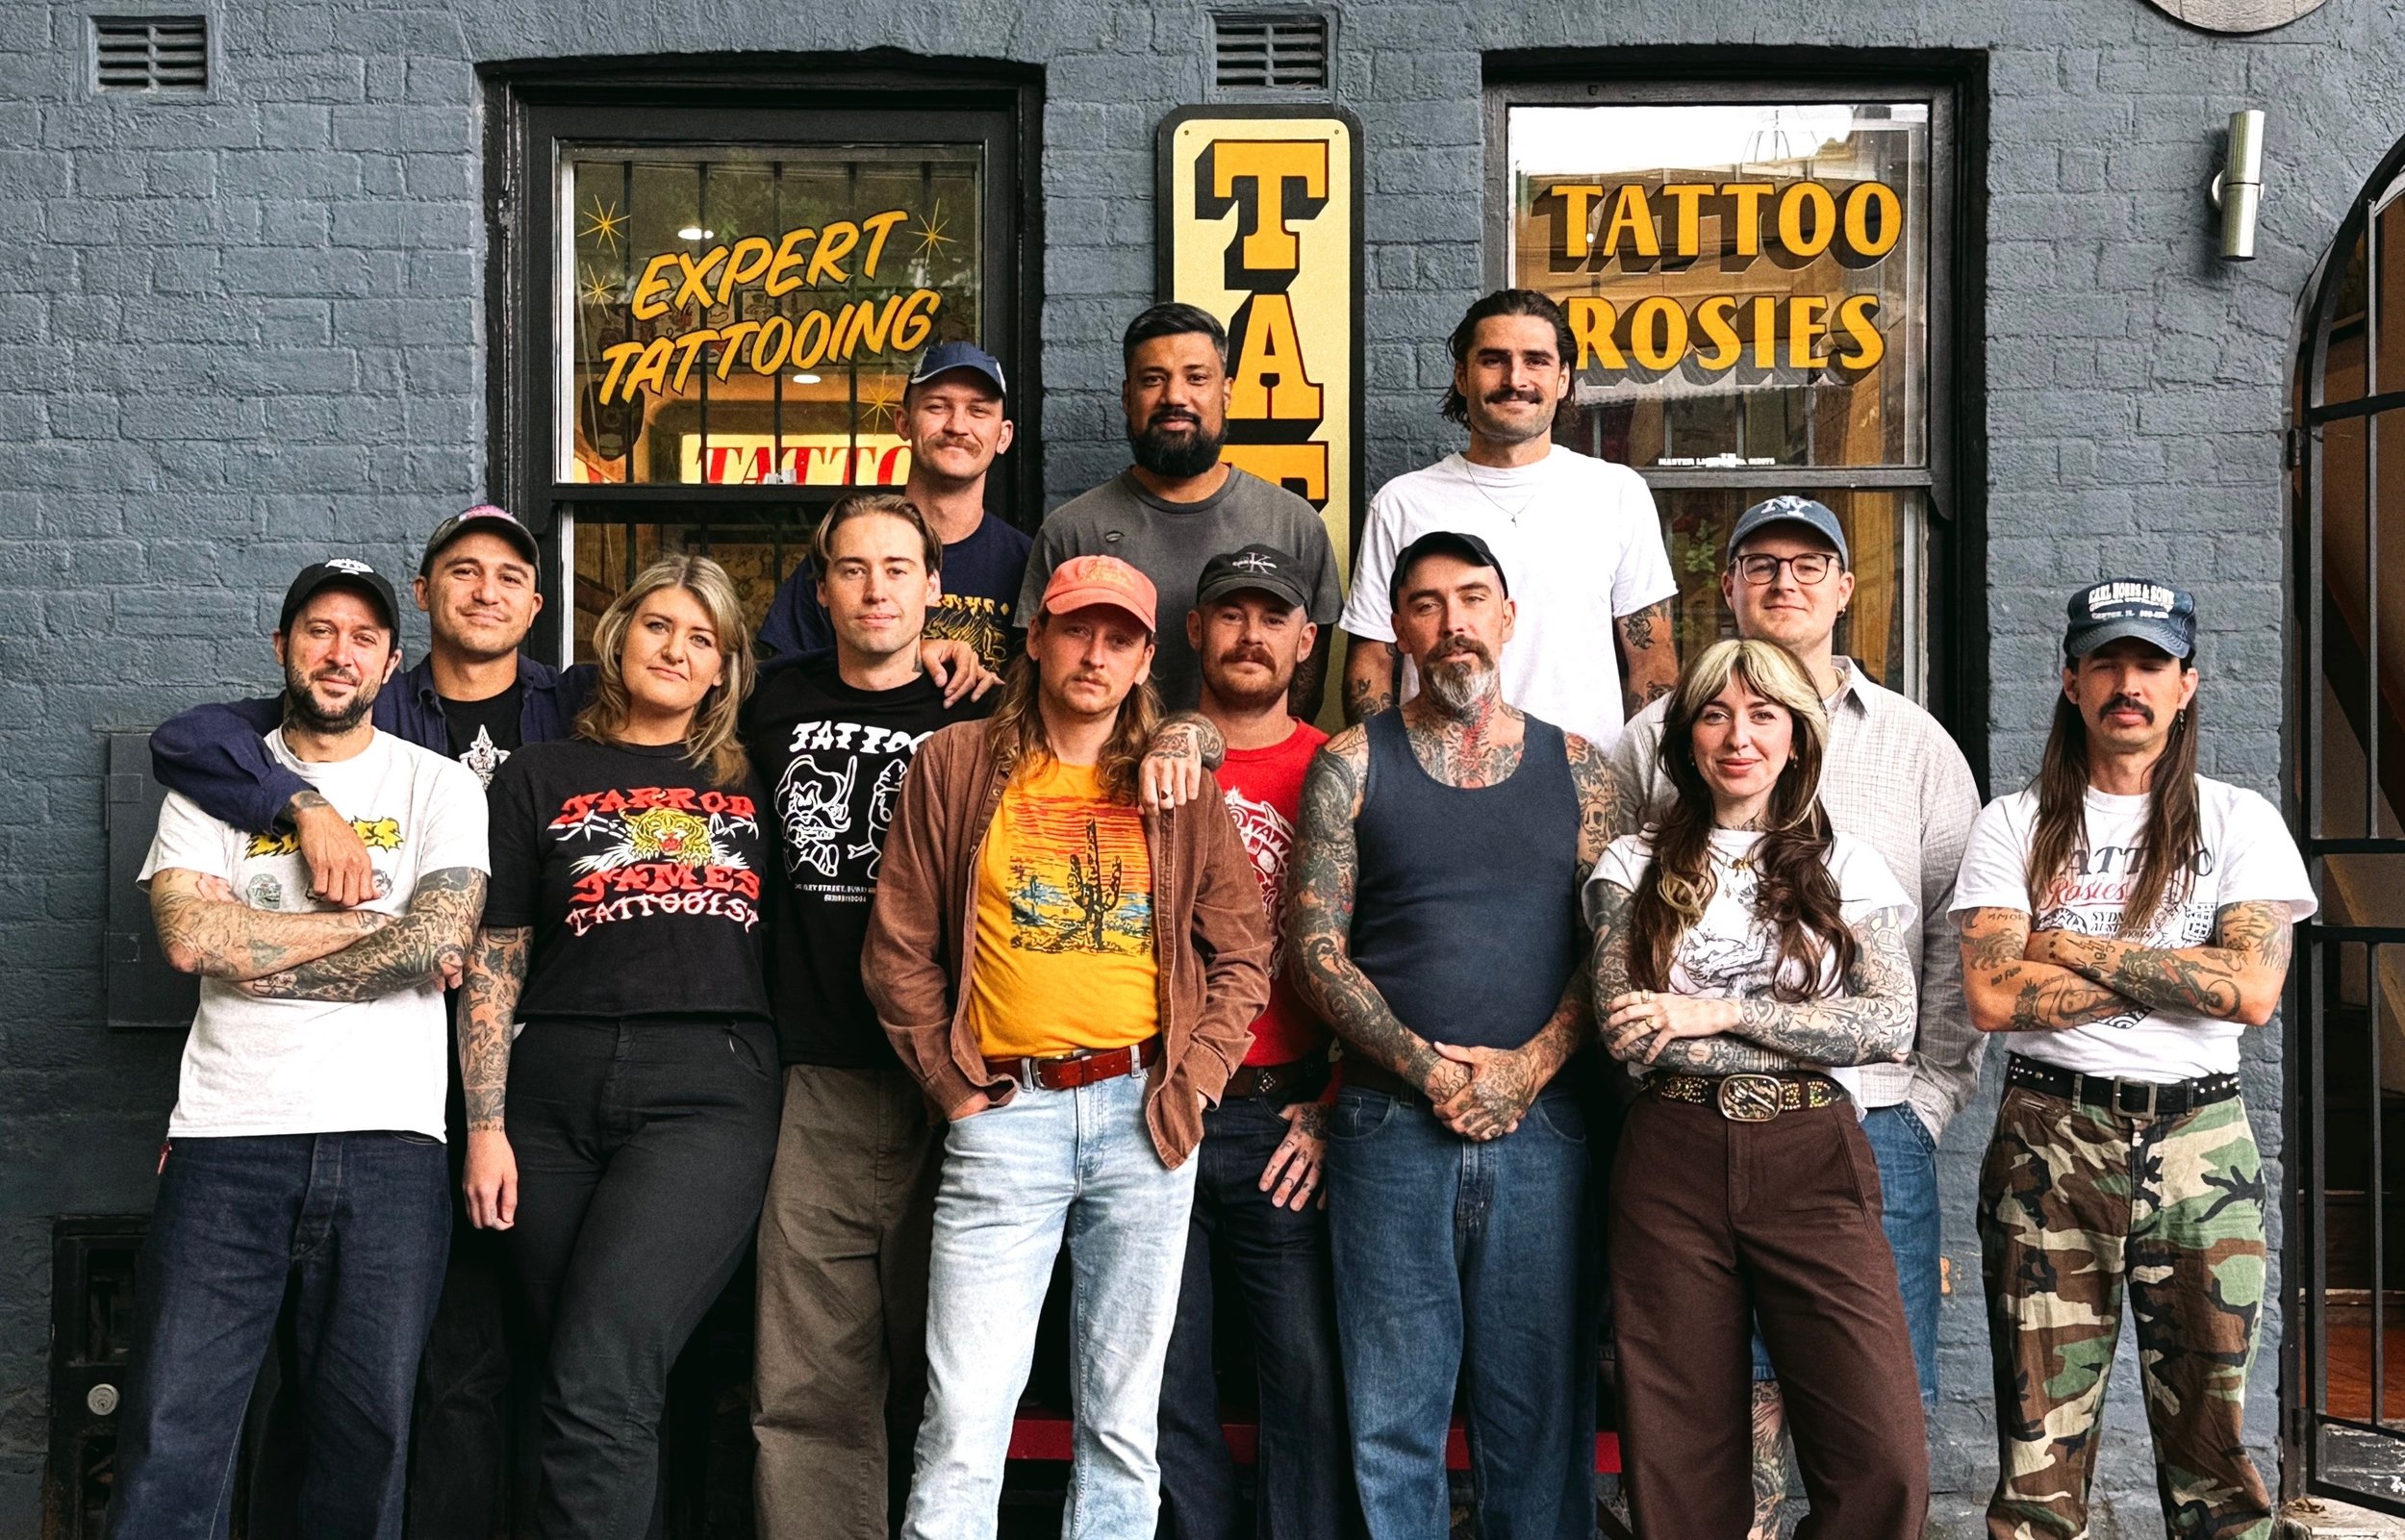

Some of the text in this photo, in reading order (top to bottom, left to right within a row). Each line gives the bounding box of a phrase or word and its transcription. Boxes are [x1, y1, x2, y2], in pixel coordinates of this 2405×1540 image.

[1539, 181, 1904, 264] TATTOO
[630, 209, 910, 321] EXPERT
[597, 288, 943, 407] TATTOOING
[1565, 294, 1886, 373] ROSIES
[1759, 494, 1812, 518] NY
[548, 786, 757, 831] JARROD
[569, 863, 760, 903] JAMES
[565, 890, 760, 937] TATTOOIST
[2091, 911, 2125, 922] SYDN
